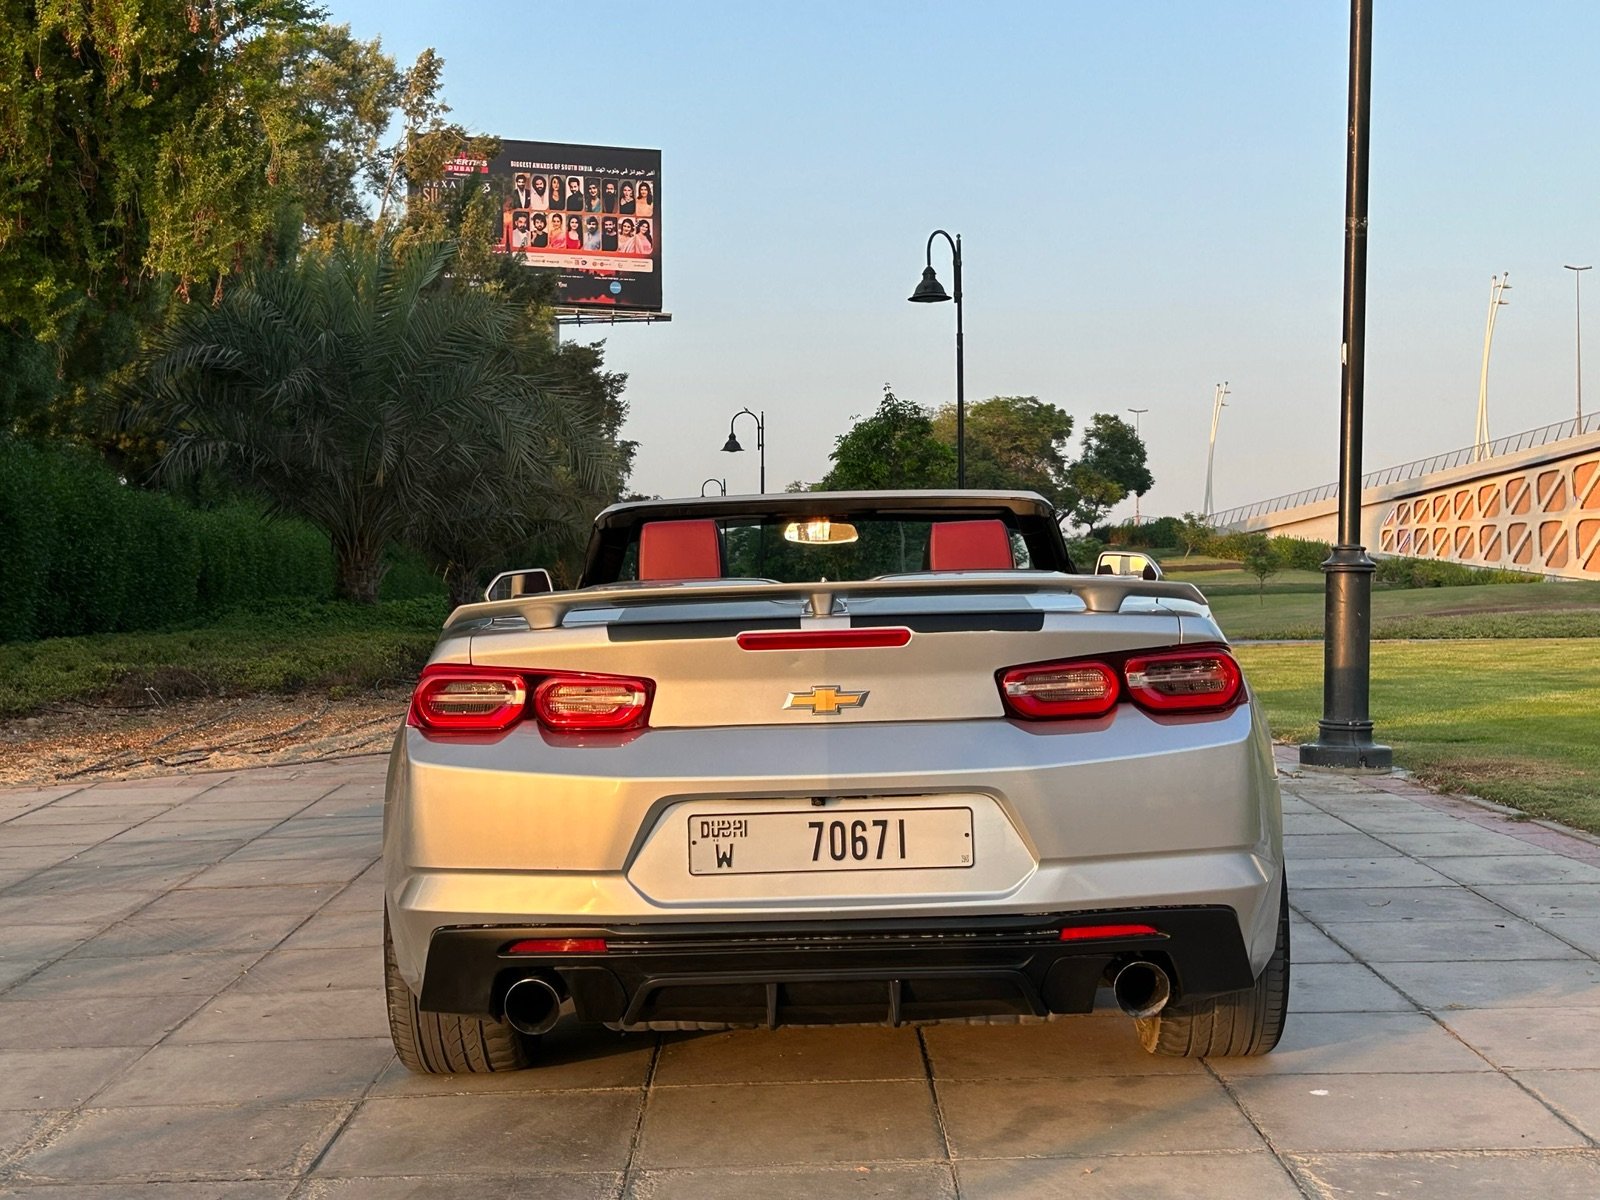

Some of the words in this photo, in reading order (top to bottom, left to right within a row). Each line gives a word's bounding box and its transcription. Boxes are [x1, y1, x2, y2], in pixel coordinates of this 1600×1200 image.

[448, 165, 474, 173] DUBAI
[510, 160, 532, 168] BIGGEST
[701, 820, 747, 838] DUBAI
[808, 819, 906, 861] 70671
[715, 843, 733, 868] W
